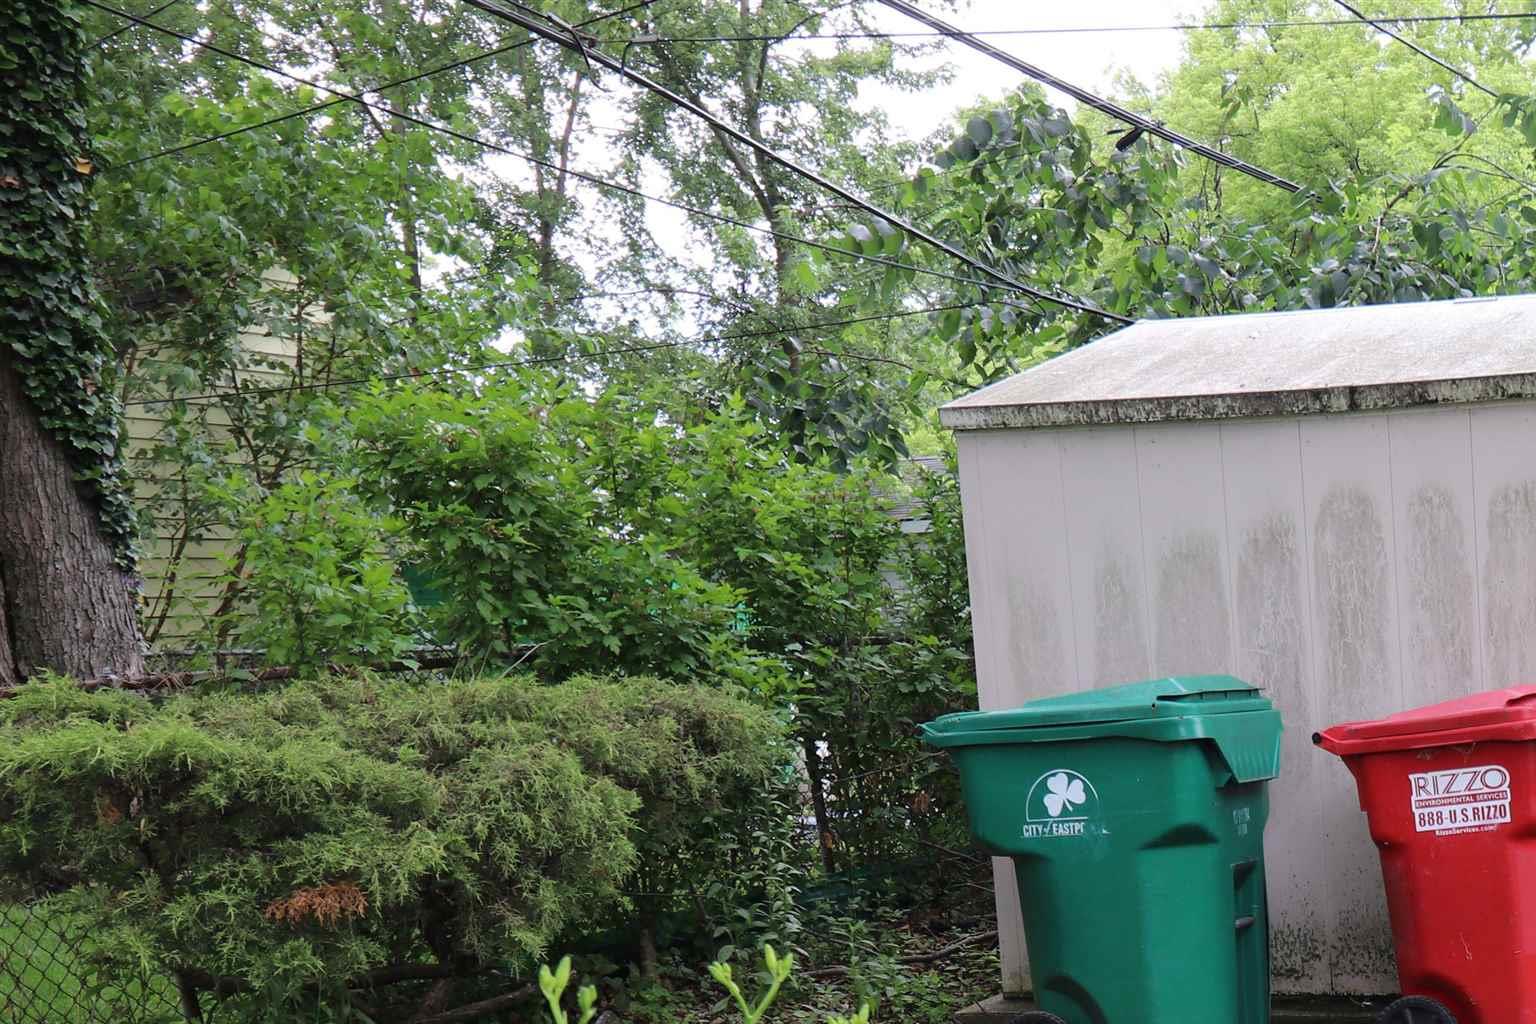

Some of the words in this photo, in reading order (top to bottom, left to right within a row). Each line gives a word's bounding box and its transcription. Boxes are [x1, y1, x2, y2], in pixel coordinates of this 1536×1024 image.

[1413, 768, 1507, 798] RIZZO
[1416, 796, 1474, 807] ENVIRONMENTAL
[1476, 791, 1507, 801] SERVICES
[1023, 824, 1043, 837] CITY
